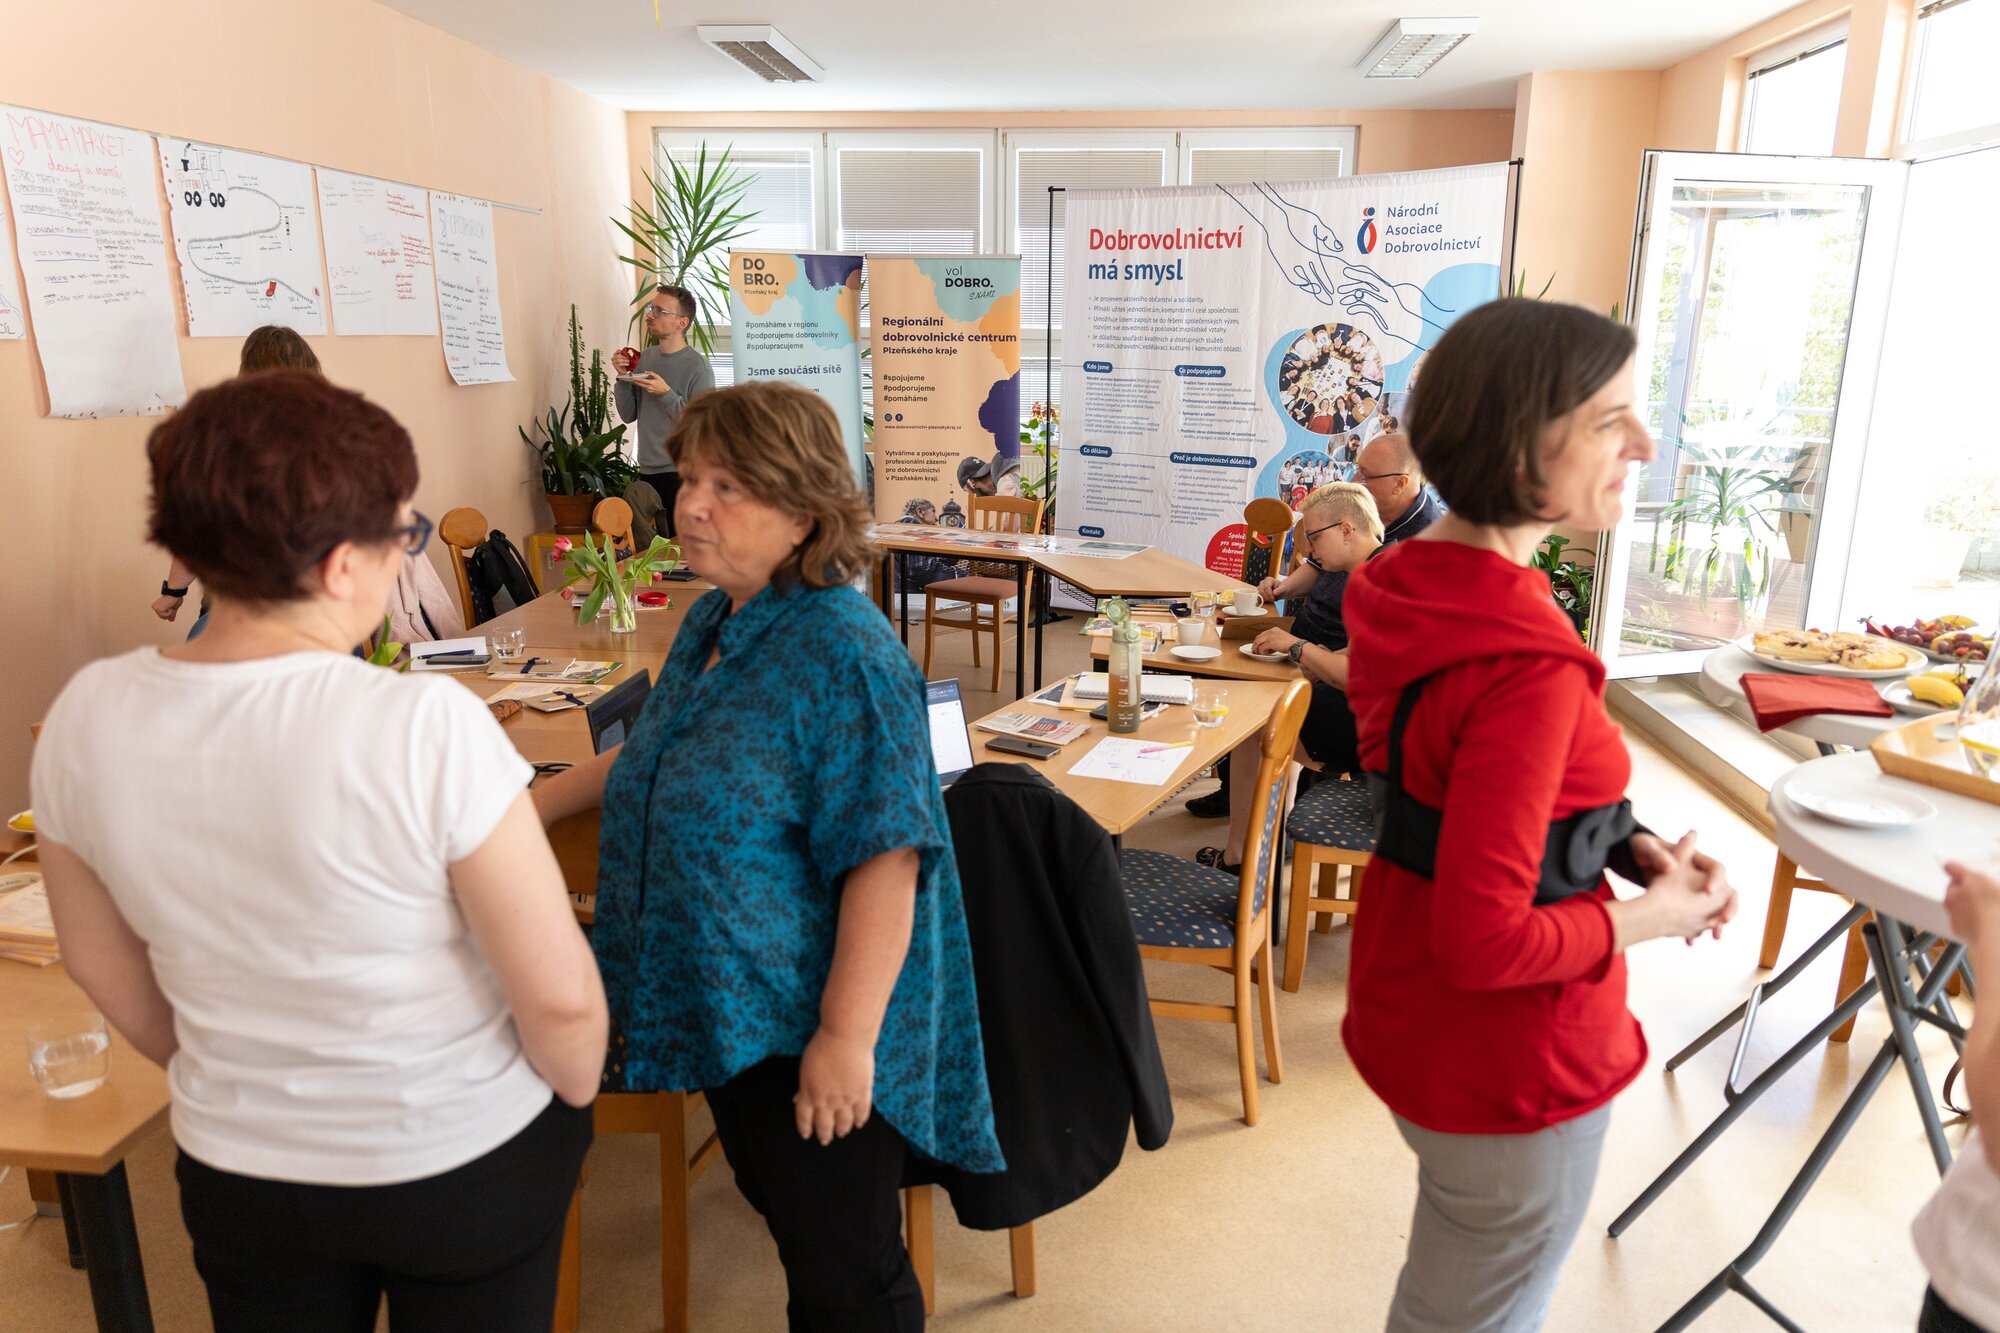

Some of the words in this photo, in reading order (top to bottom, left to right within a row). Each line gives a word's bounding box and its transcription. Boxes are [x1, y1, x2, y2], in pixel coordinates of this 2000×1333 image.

[1387, 203, 1439, 218] Národní
[1386, 222, 1442, 236] Asociace
[1089, 225, 1243, 251] Dobrovolnictví
[1385, 237, 1481, 253] Dobrovolnictví
[743, 258, 765, 270] DO
[945, 266, 963, 276] vol
[1088, 259, 1118, 280] má
[1124, 259, 1183, 285] smysl
[744, 273, 779, 285] BRO.
[945, 278, 994, 288] DOBRO.
[882, 317, 944, 328] Regionální
[746, 332, 794, 340] #podporujeme
[882, 332, 964, 342] dobrovolnické
[968, 334, 1016, 342] centrum
[883, 346, 933, 354] Plzeňského
[936, 347, 958, 355] kraje
[747, 367, 776, 376] Jsme
[778, 365, 820, 375] součástí
[822, 364, 842, 374] sítě
[884, 374, 925, 382] #spojujeme
[1192, 456, 1228, 464] dobrovolnictví
[1230, 457, 1251, 465] důležité
[1228, 532, 1246, 540] Společ
